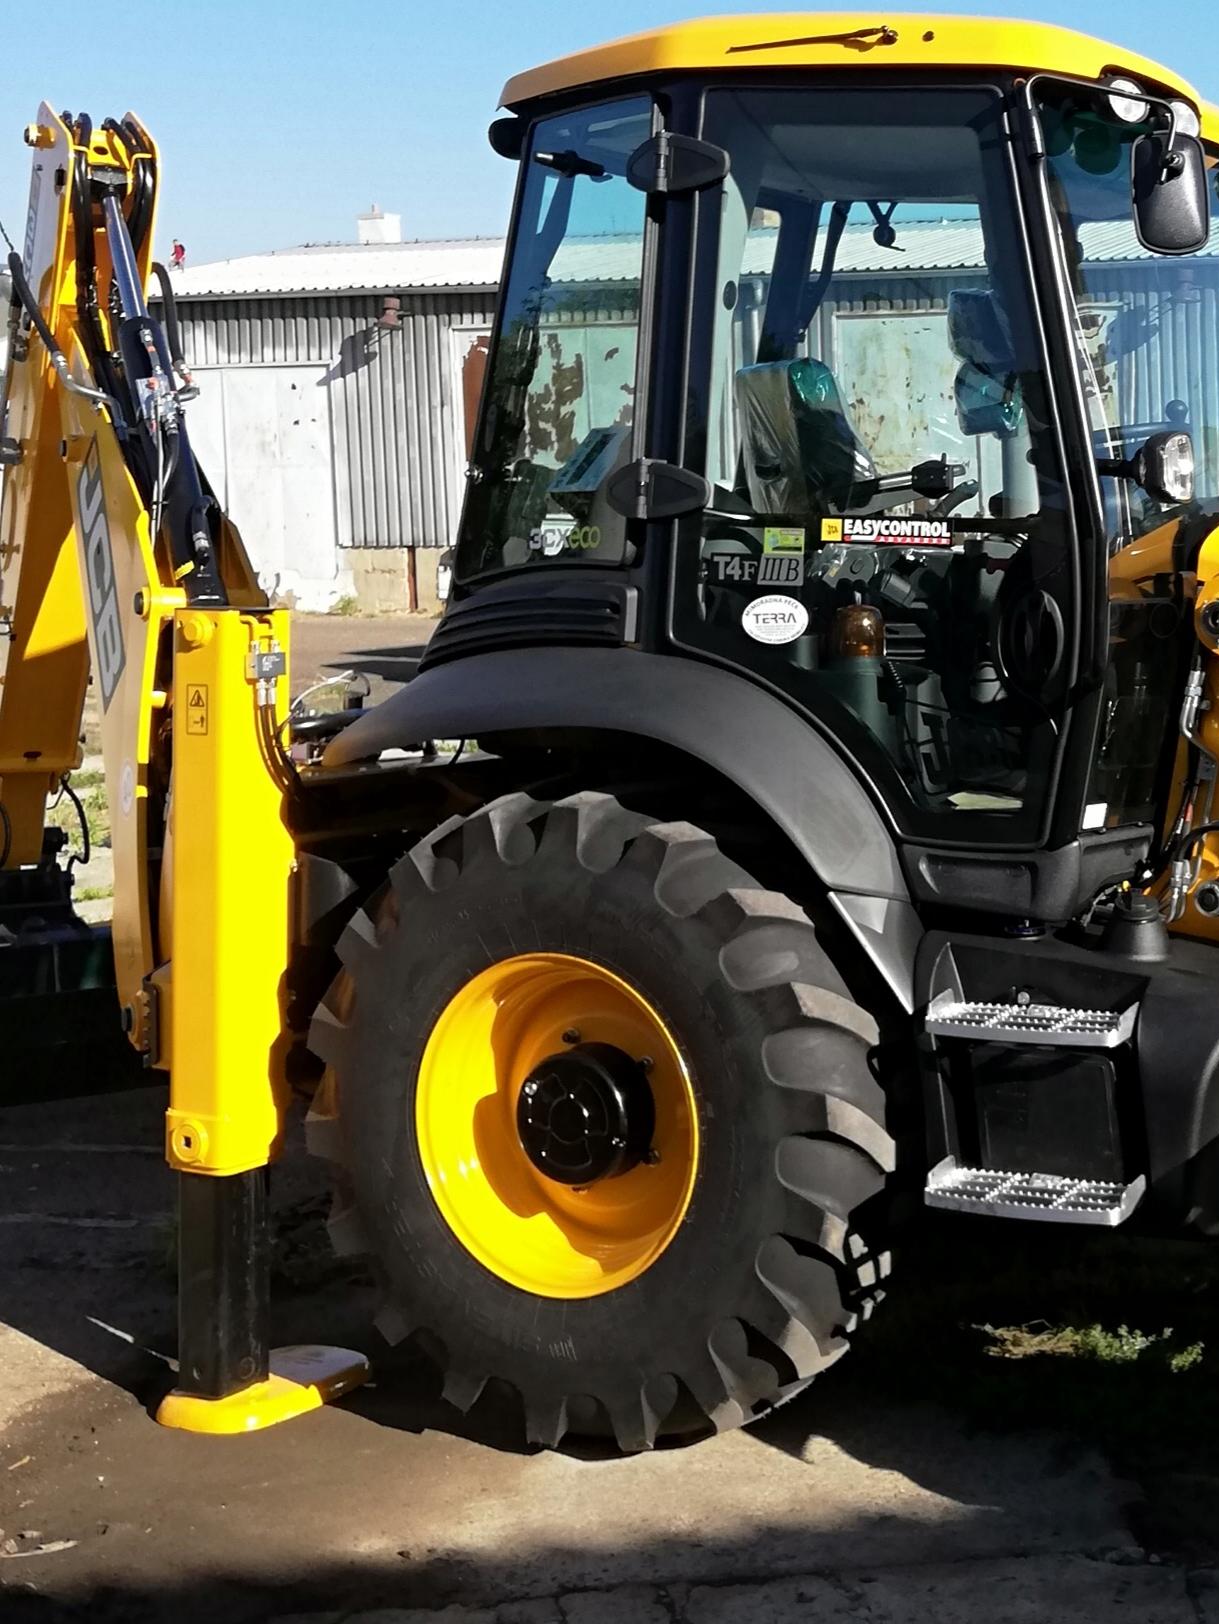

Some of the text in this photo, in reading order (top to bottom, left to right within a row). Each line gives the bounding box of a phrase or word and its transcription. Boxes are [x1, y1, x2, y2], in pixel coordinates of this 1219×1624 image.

[843, 518, 951, 541] EASYCONTROL
[80, 464, 121, 697] JCB
[753, 612, 797, 624] TERRA
